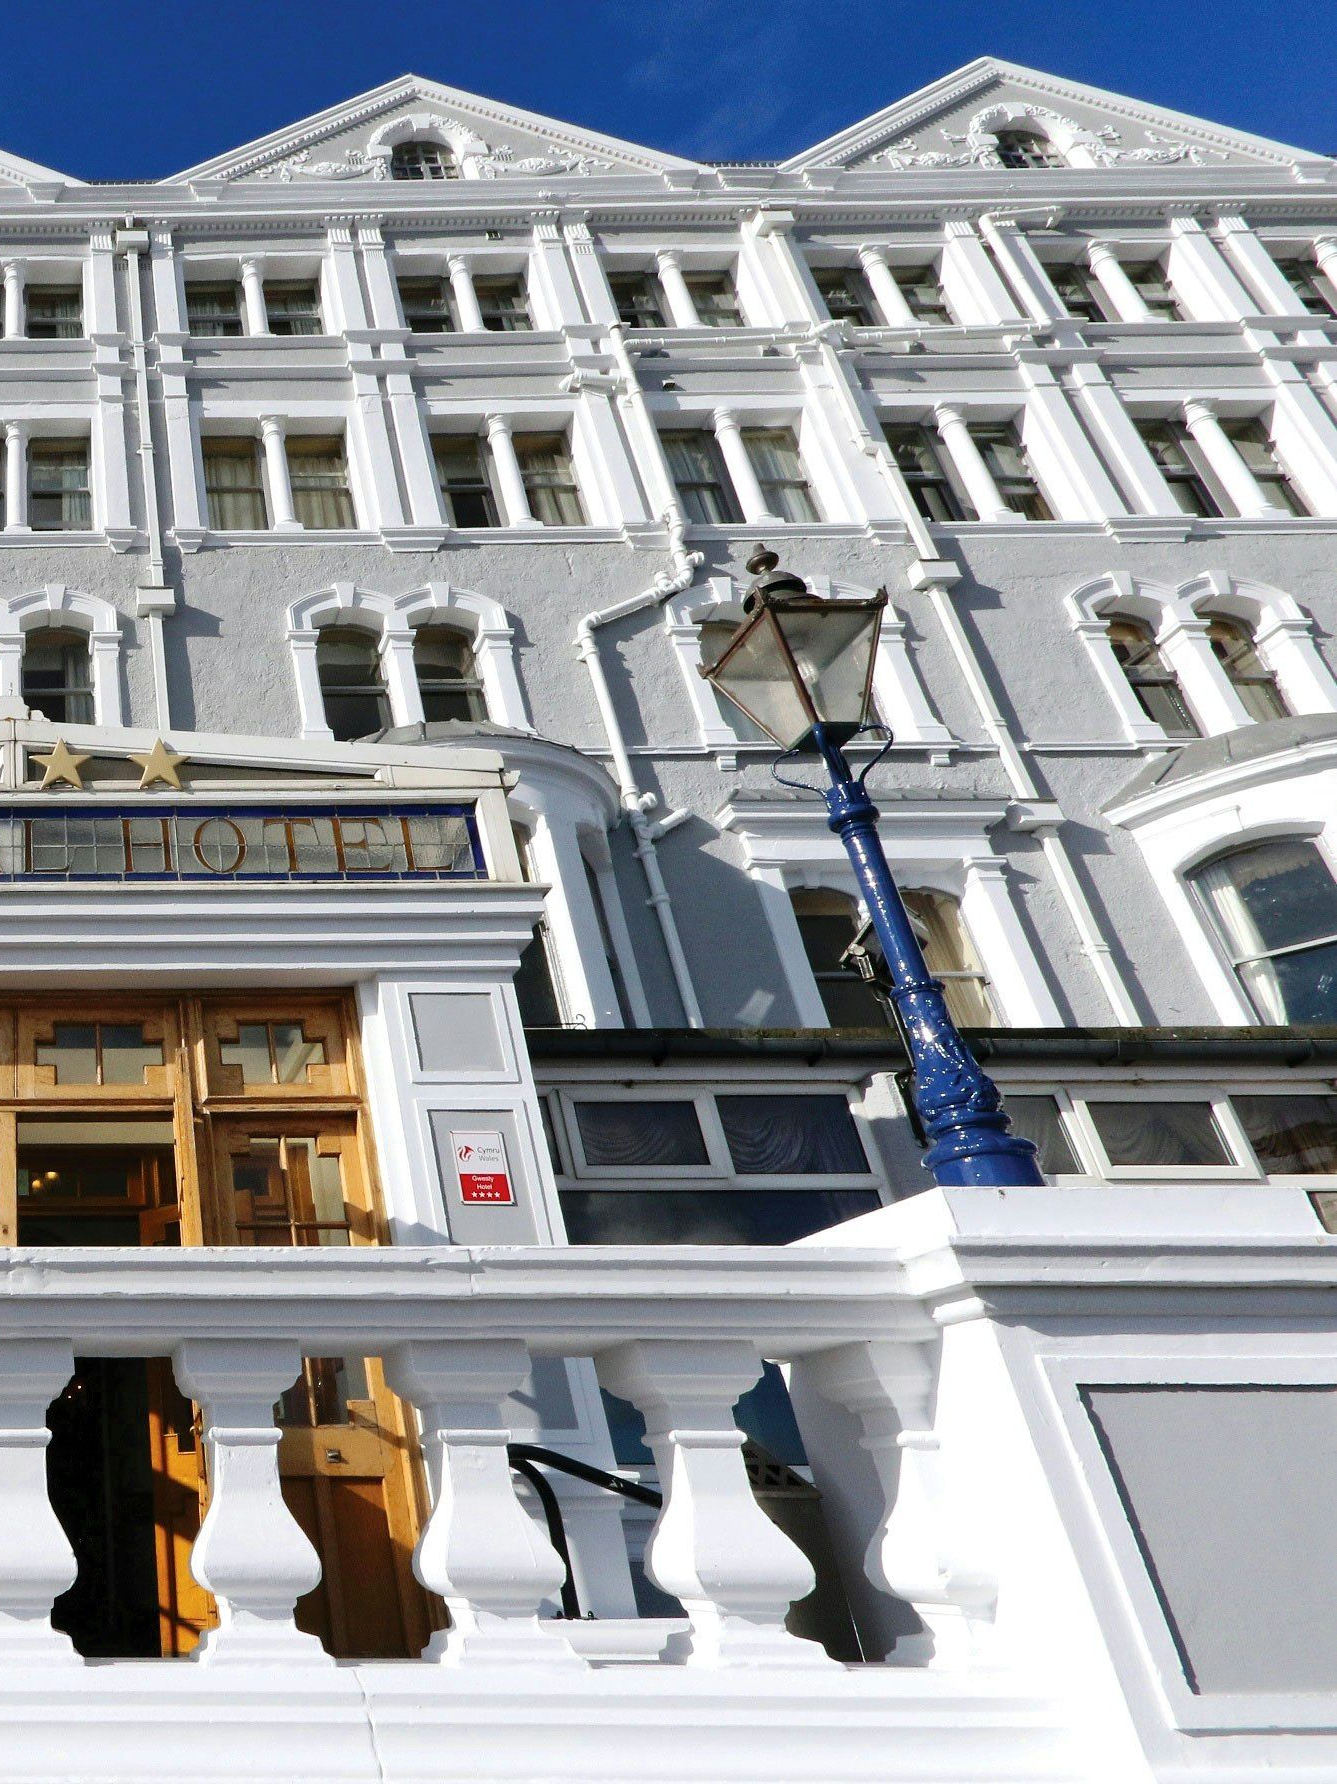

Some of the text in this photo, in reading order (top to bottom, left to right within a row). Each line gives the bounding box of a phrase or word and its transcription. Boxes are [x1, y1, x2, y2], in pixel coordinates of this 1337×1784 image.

[121, 817, 454, 873] HOTEL
[477, 1146, 500, 1155] Cymru
[472, 1175, 494, 1183] Gwesty
